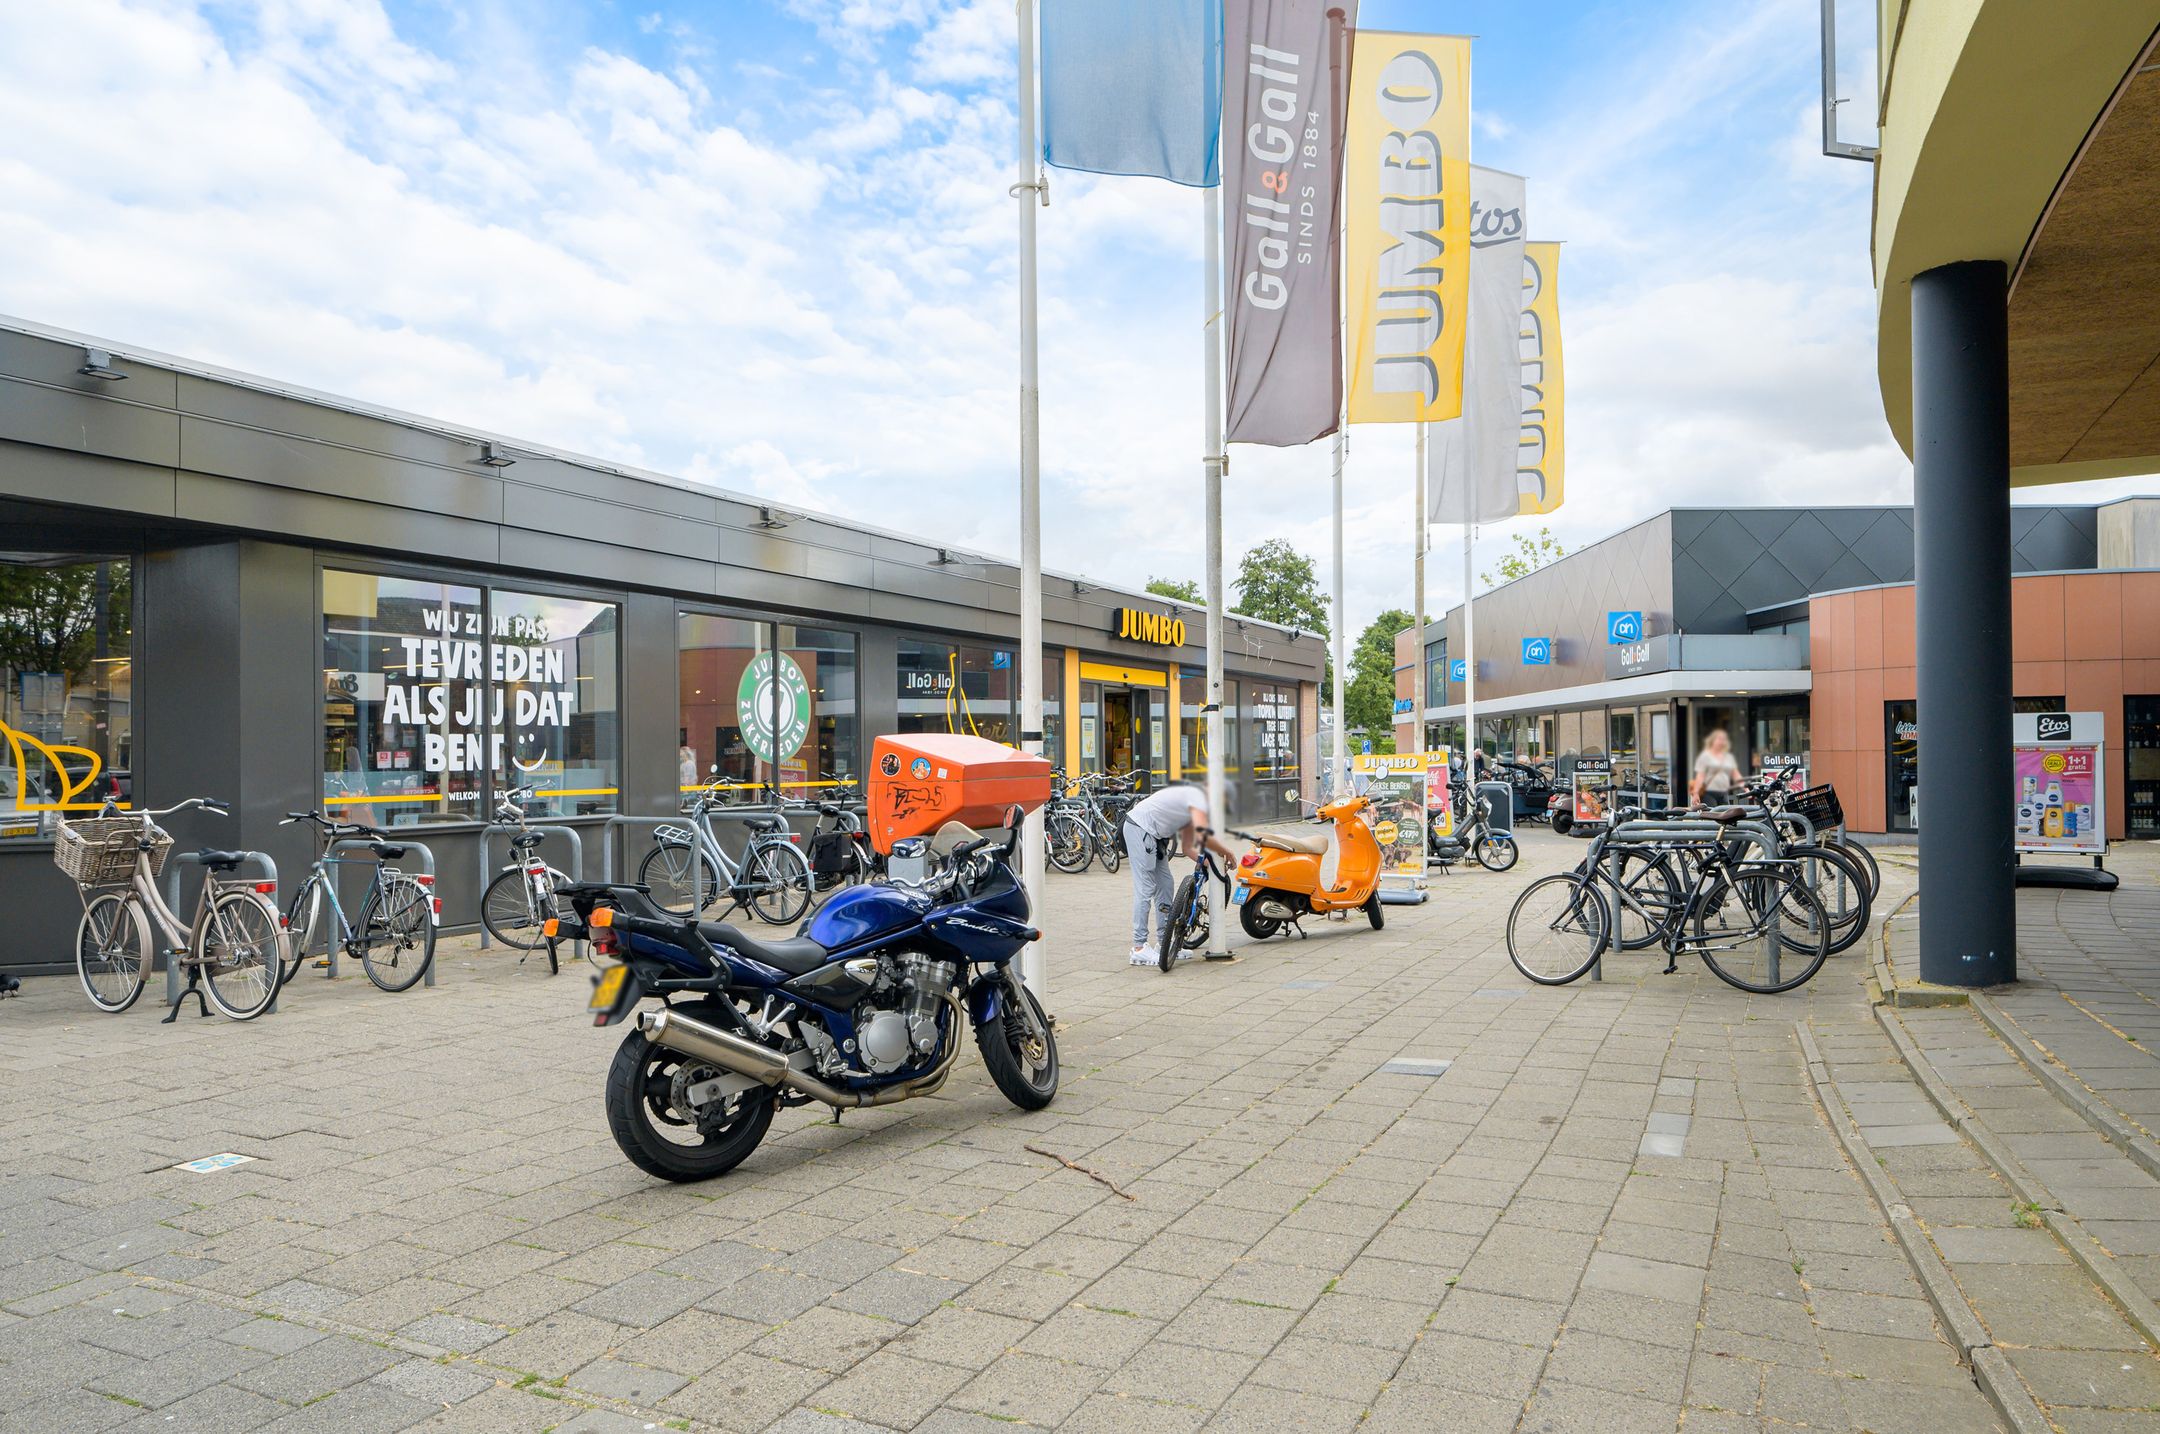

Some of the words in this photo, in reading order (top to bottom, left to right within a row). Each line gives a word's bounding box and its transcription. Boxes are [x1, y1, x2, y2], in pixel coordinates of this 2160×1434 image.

[1248, 43, 1300, 164] Gall
[1303, 111, 1320, 168] 1884
[1298, 186, 1315, 265] SINDS
[1373, 49, 1445, 408] JUMBO
[1470, 200, 1523, 237] tos
[422, 608, 461, 633] WIJ
[515, 617, 547, 640] PAS
[1120, 608, 1186, 647] JUMBO
[401, 637, 563, 683] TEVREDEN
[754, 657, 805, 694] JUBO'S
[382, 685, 446, 725] ALS
[455, 688, 504, 726] JIJ
[515, 690, 573, 726] DAT
[2039, 718, 2069, 732] Etos
[425, 733, 504, 772] BENT
[1364, 758, 1418, 769] JUMBO
[2068, 755, 2086, 764] 1+1
[448, 791, 480, 801] WELKOM
[946, 917, 998, 933] Bandit
